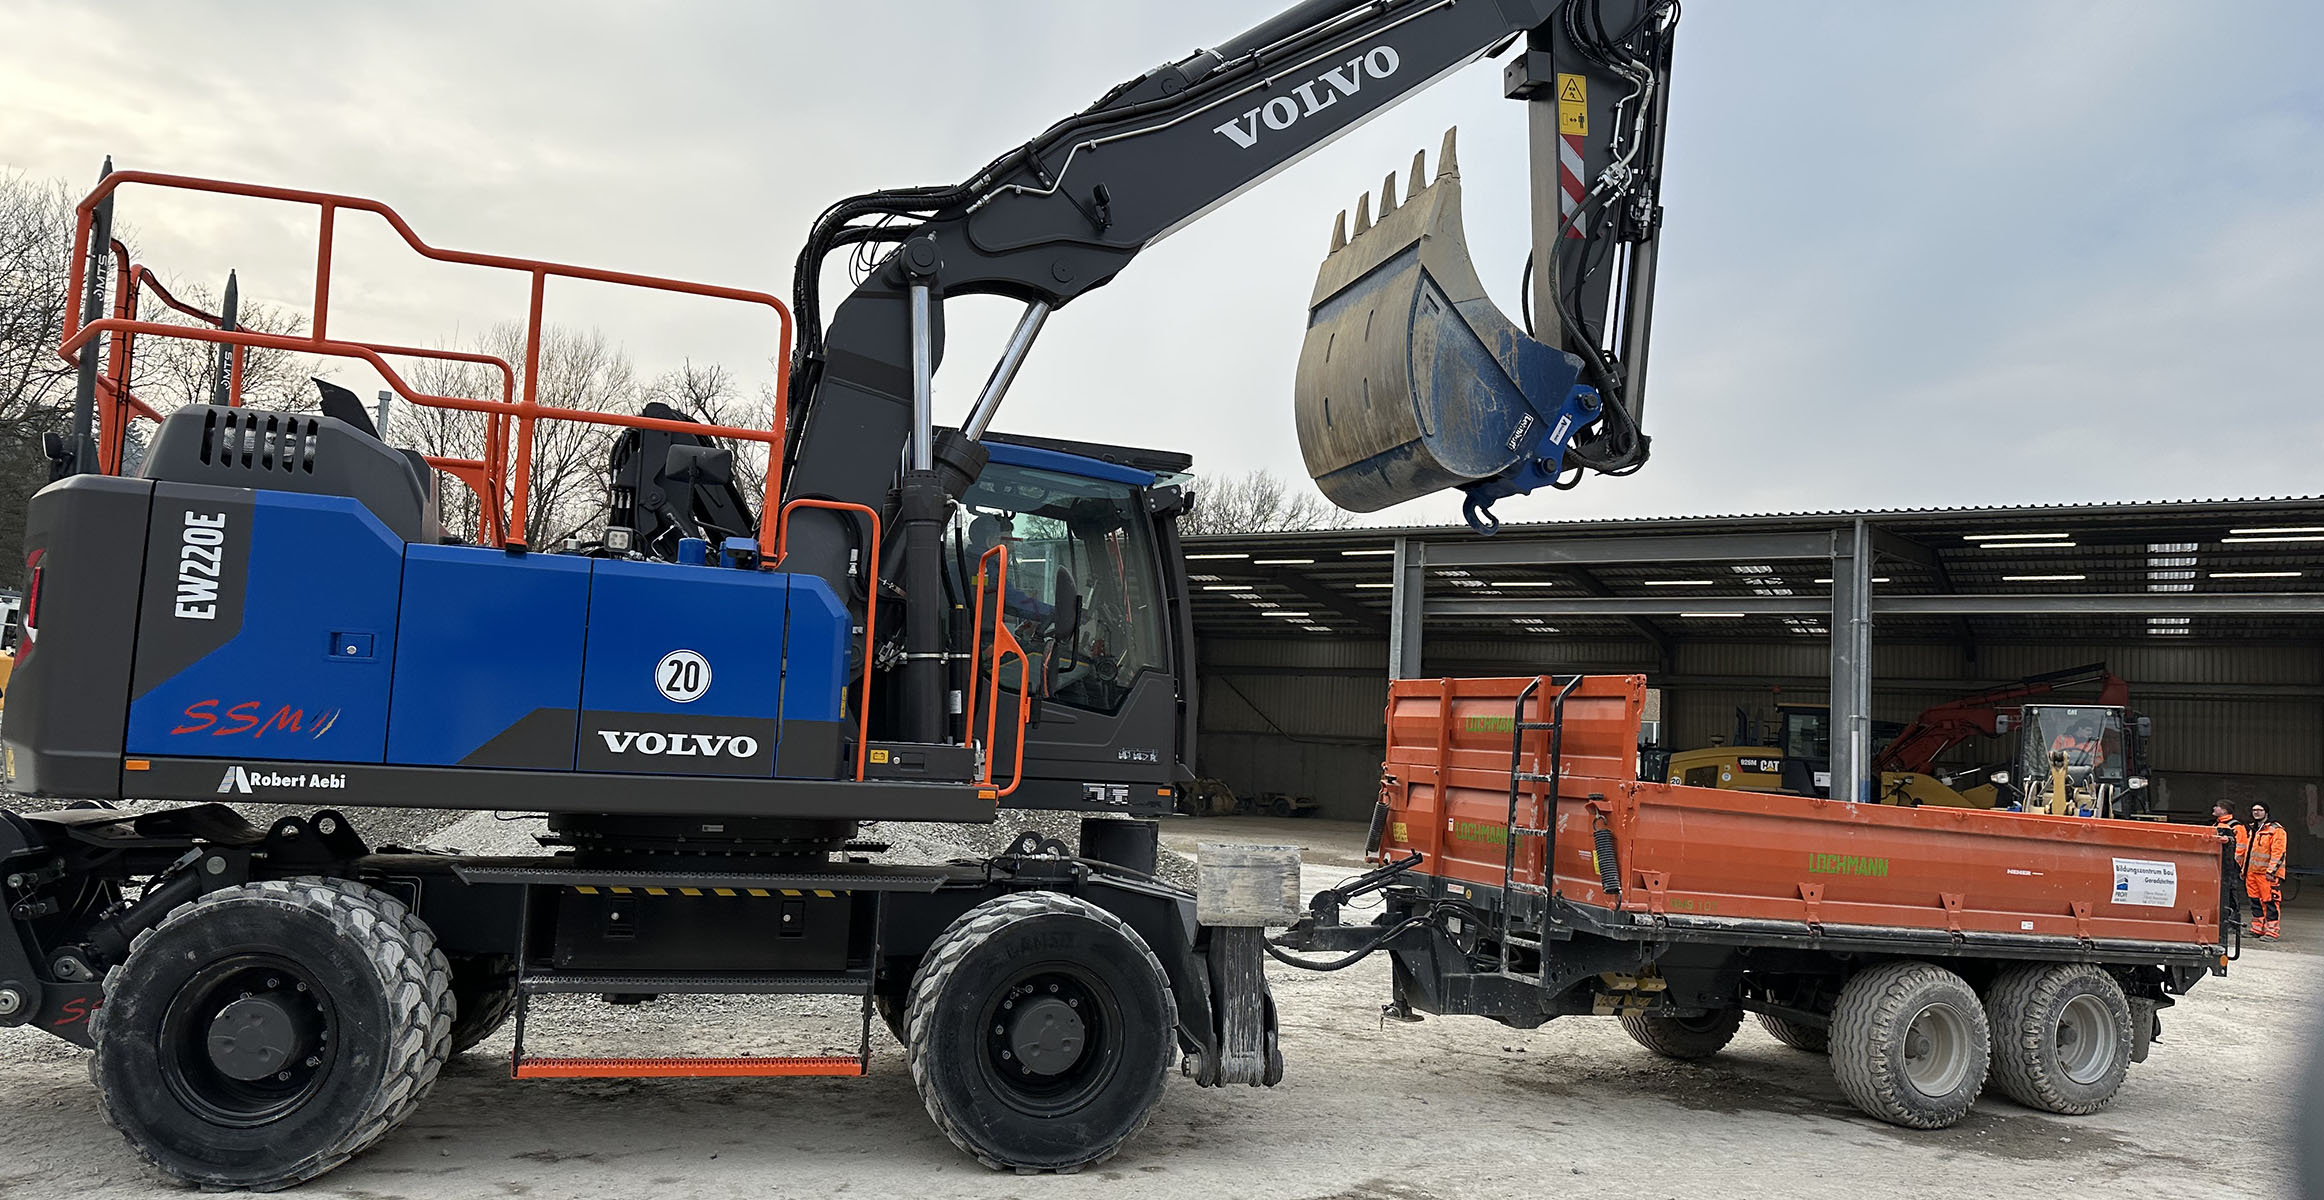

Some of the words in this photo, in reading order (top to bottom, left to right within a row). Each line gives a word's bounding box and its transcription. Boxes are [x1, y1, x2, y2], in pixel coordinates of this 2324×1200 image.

[1213, 45, 1400, 149] VOLVO
[96, 253, 108, 288] MTS
[222, 351, 233, 380] MTS
[175, 510, 226, 620] EW220E
[665, 659, 700, 693] 20
[170, 699, 304, 739] SSM
[1465, 715, 1515, 734] LOCHMAN
[597, 730, 759, 758] VOLVO
[1760, 759, 1780, 772] CAT
[250, 771, 306, 788] Robert
[309, 773, 346, 789] Aebi
[1809, 852, 1889, 877] LOCHMANN
[2163, 868, 2174, 877] Bau
